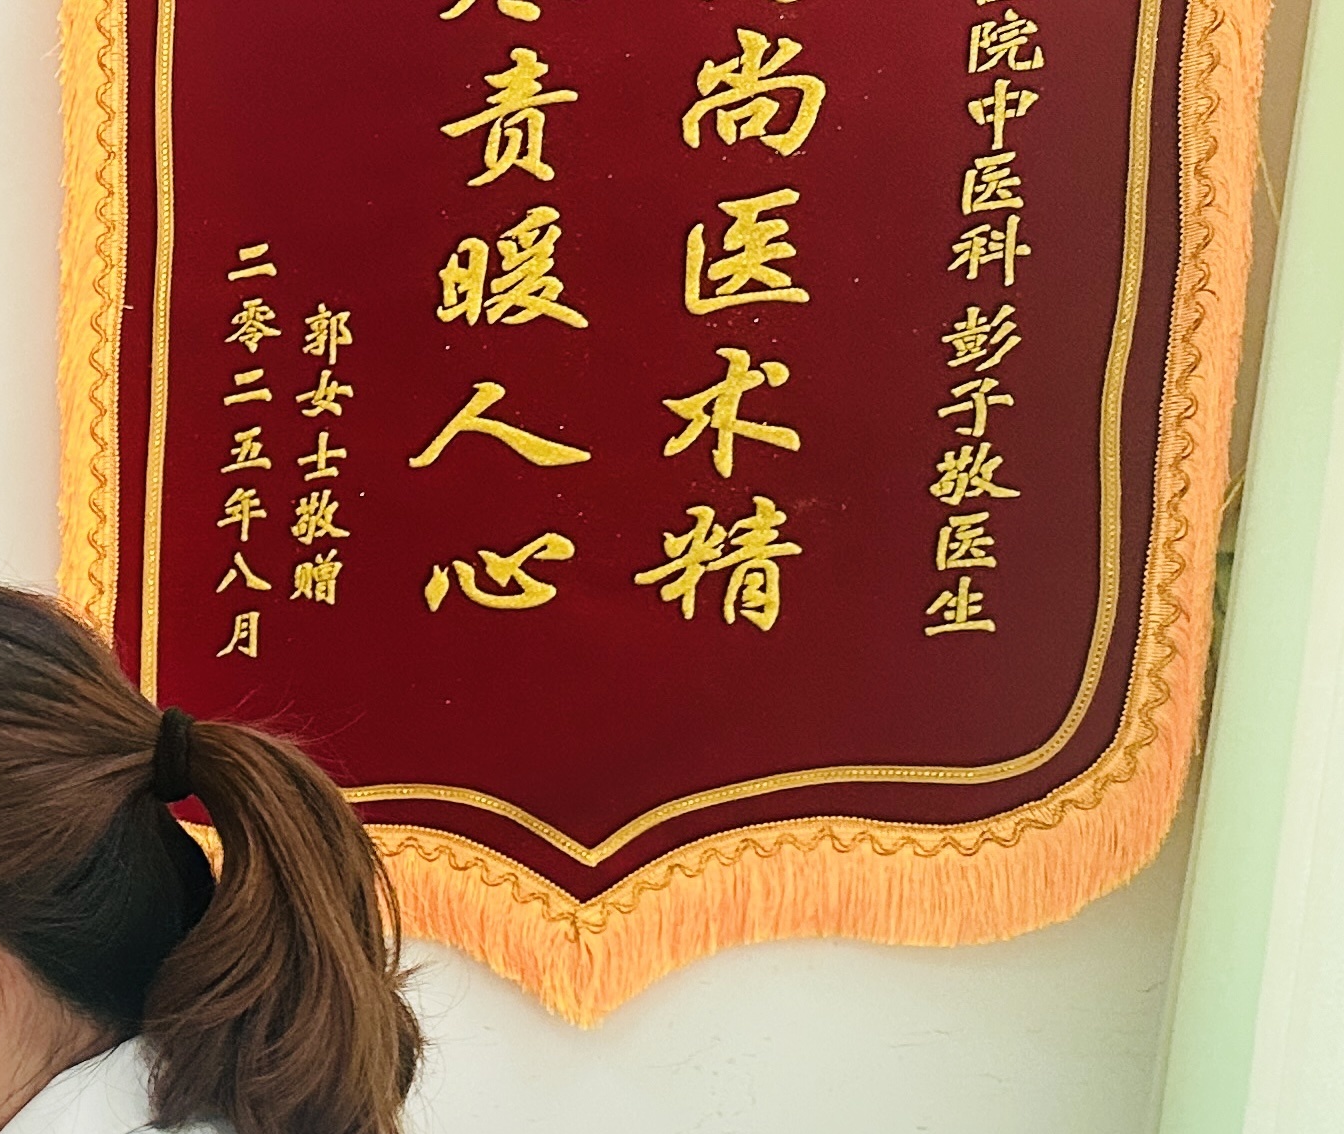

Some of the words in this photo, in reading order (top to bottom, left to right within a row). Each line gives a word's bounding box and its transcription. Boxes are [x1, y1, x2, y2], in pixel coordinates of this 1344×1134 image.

[409, 0, 592, 612] 责暖人心
[634, 0, 828, 632] 尚医术精
[947, 0, 1046, 287] 院中医科
[215, 243, 282, 659] 二零二五年八月
[289, 302, 355, 606] 郭女士敬赠
[924, 304, 1022, 637] 彭子敬医生
